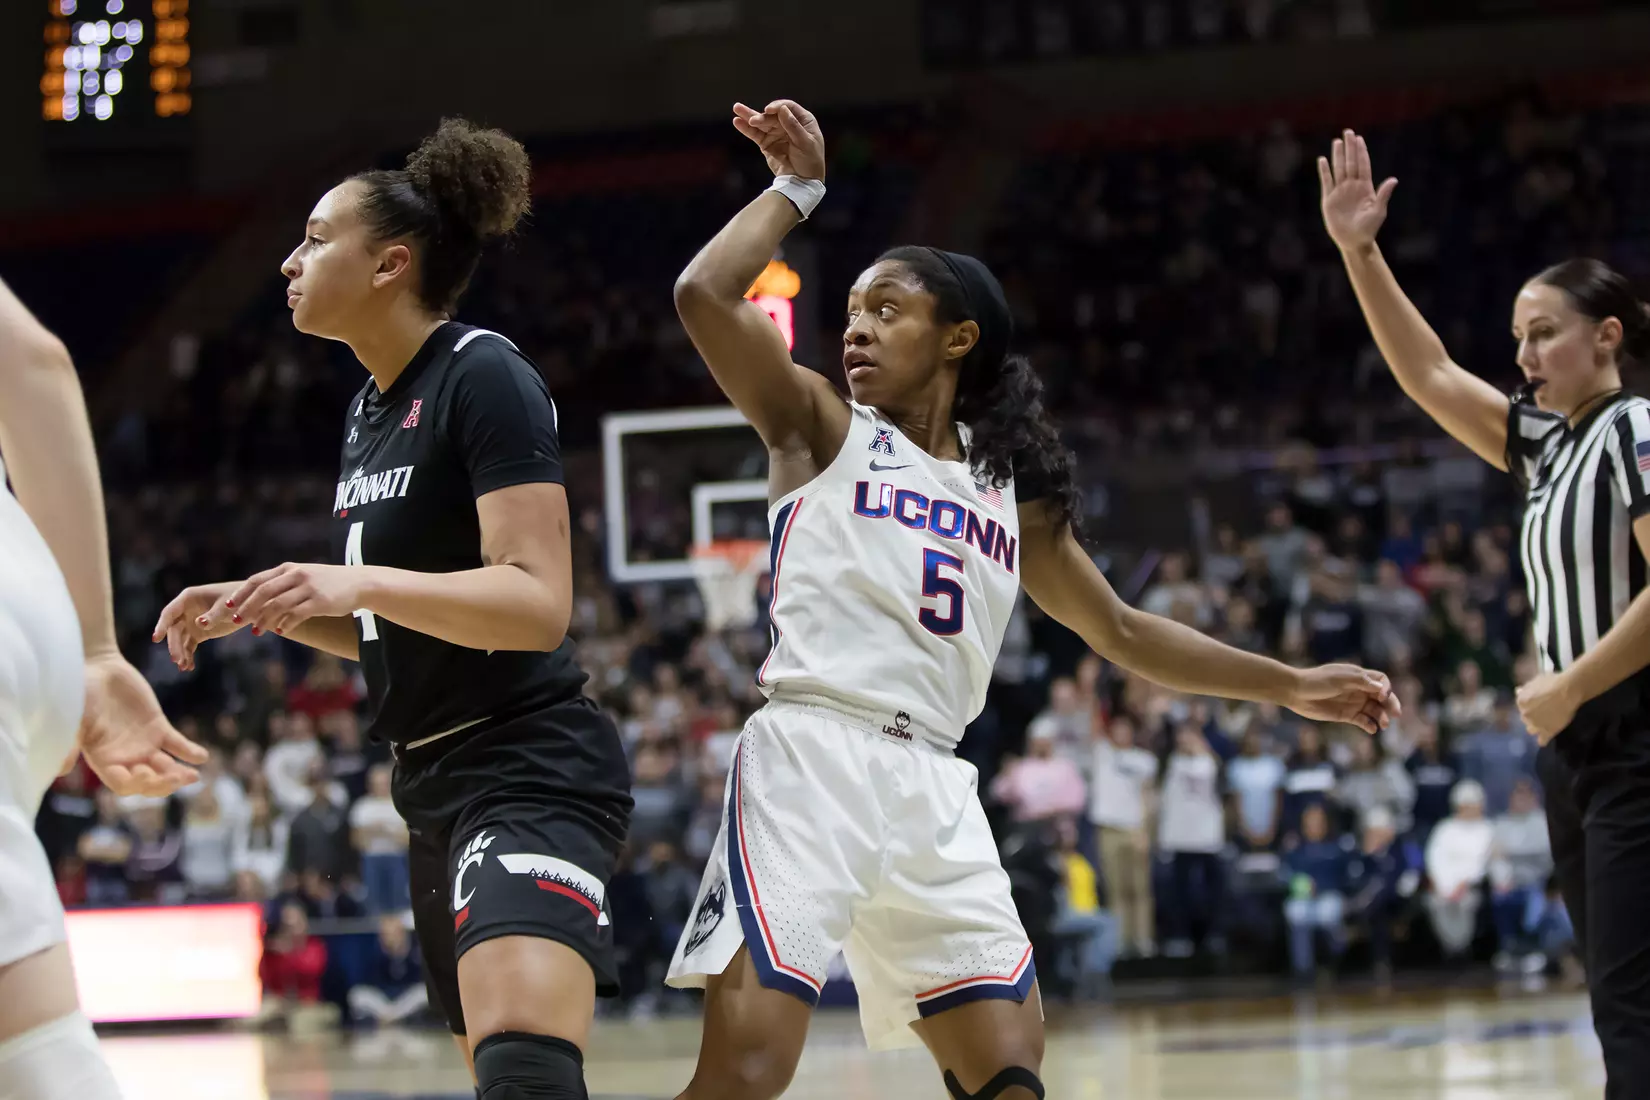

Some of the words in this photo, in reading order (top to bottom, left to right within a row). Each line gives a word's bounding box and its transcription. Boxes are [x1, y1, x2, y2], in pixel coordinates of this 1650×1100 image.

[853, 481, 1017, 575] UCONN
[918, 547, 965, 637] 5
[882, 725, 913, 741] UCONN
